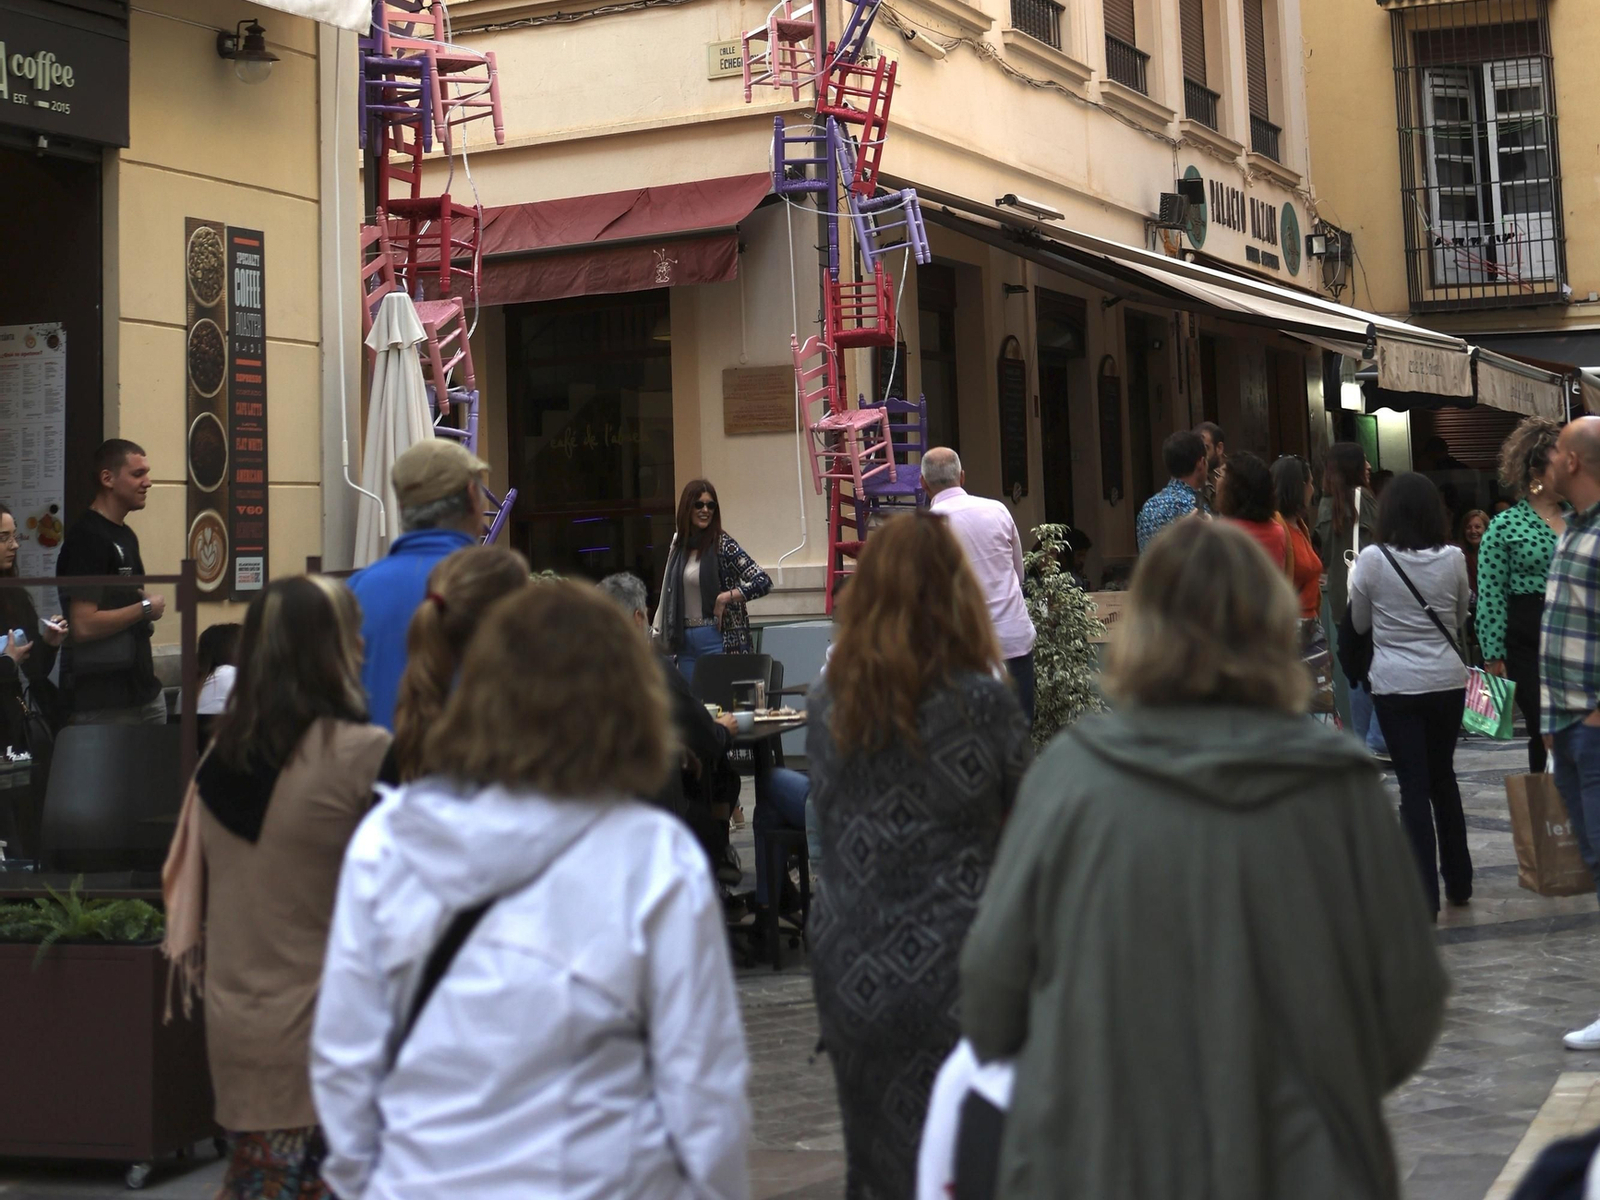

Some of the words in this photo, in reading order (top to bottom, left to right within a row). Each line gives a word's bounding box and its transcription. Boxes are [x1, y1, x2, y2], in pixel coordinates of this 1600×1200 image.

[11, 50, 75, 91] coffee
[720, 46, 735, 56] CALLE
[13, 93, 29, 105] EST.
[51, 100, 71, 115] 2015
[1209, 179, 1246, 234] PALACIO
[234, 267, 261, 309] COFFEE
